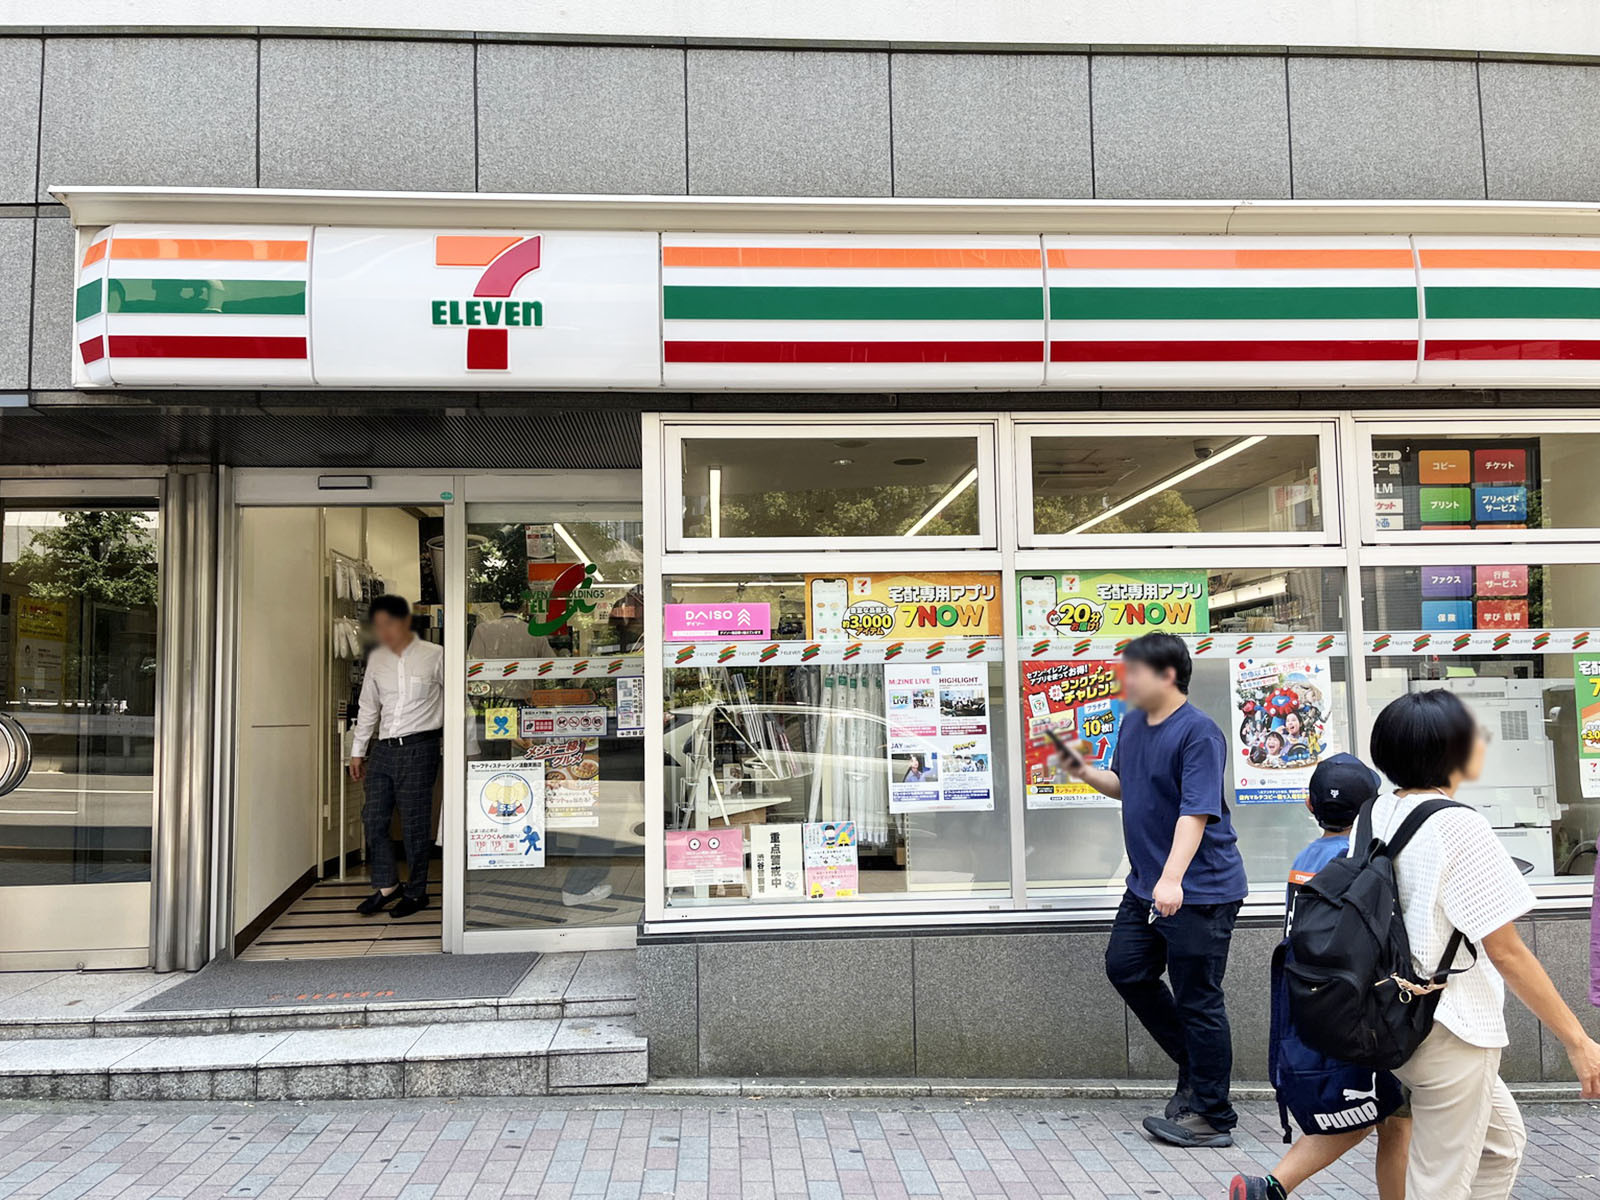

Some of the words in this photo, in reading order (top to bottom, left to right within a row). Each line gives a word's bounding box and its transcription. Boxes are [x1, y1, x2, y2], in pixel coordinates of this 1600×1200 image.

[1432, 462, 1456, 470] コピー
[1484, 462, 1515, 470] チケット
[1481, 495, 1520, 504] プリペイド
[1430, 501, 1460, 510] プリント
[1484, 504, 1517, 513] サービス
[1485, 580, 1518, 588] サービス
[888, 584, 996, 603] 宅配専用アプリ
[1096, 582, 1202, 601] 宅配専用アプリ
[685, 610, 733, 620] DAISO
[902, 604, 985, 628] 7NOW
[1109, 602, 1192, 625] 7NOW
[939, 676, 979, 684] HIGHLIGHT
[552, 752, 584, 768] グルメ
[769, 831, 783, 889] 重点警戒中
[1313, 1101, 1379, 1131] PUMA
